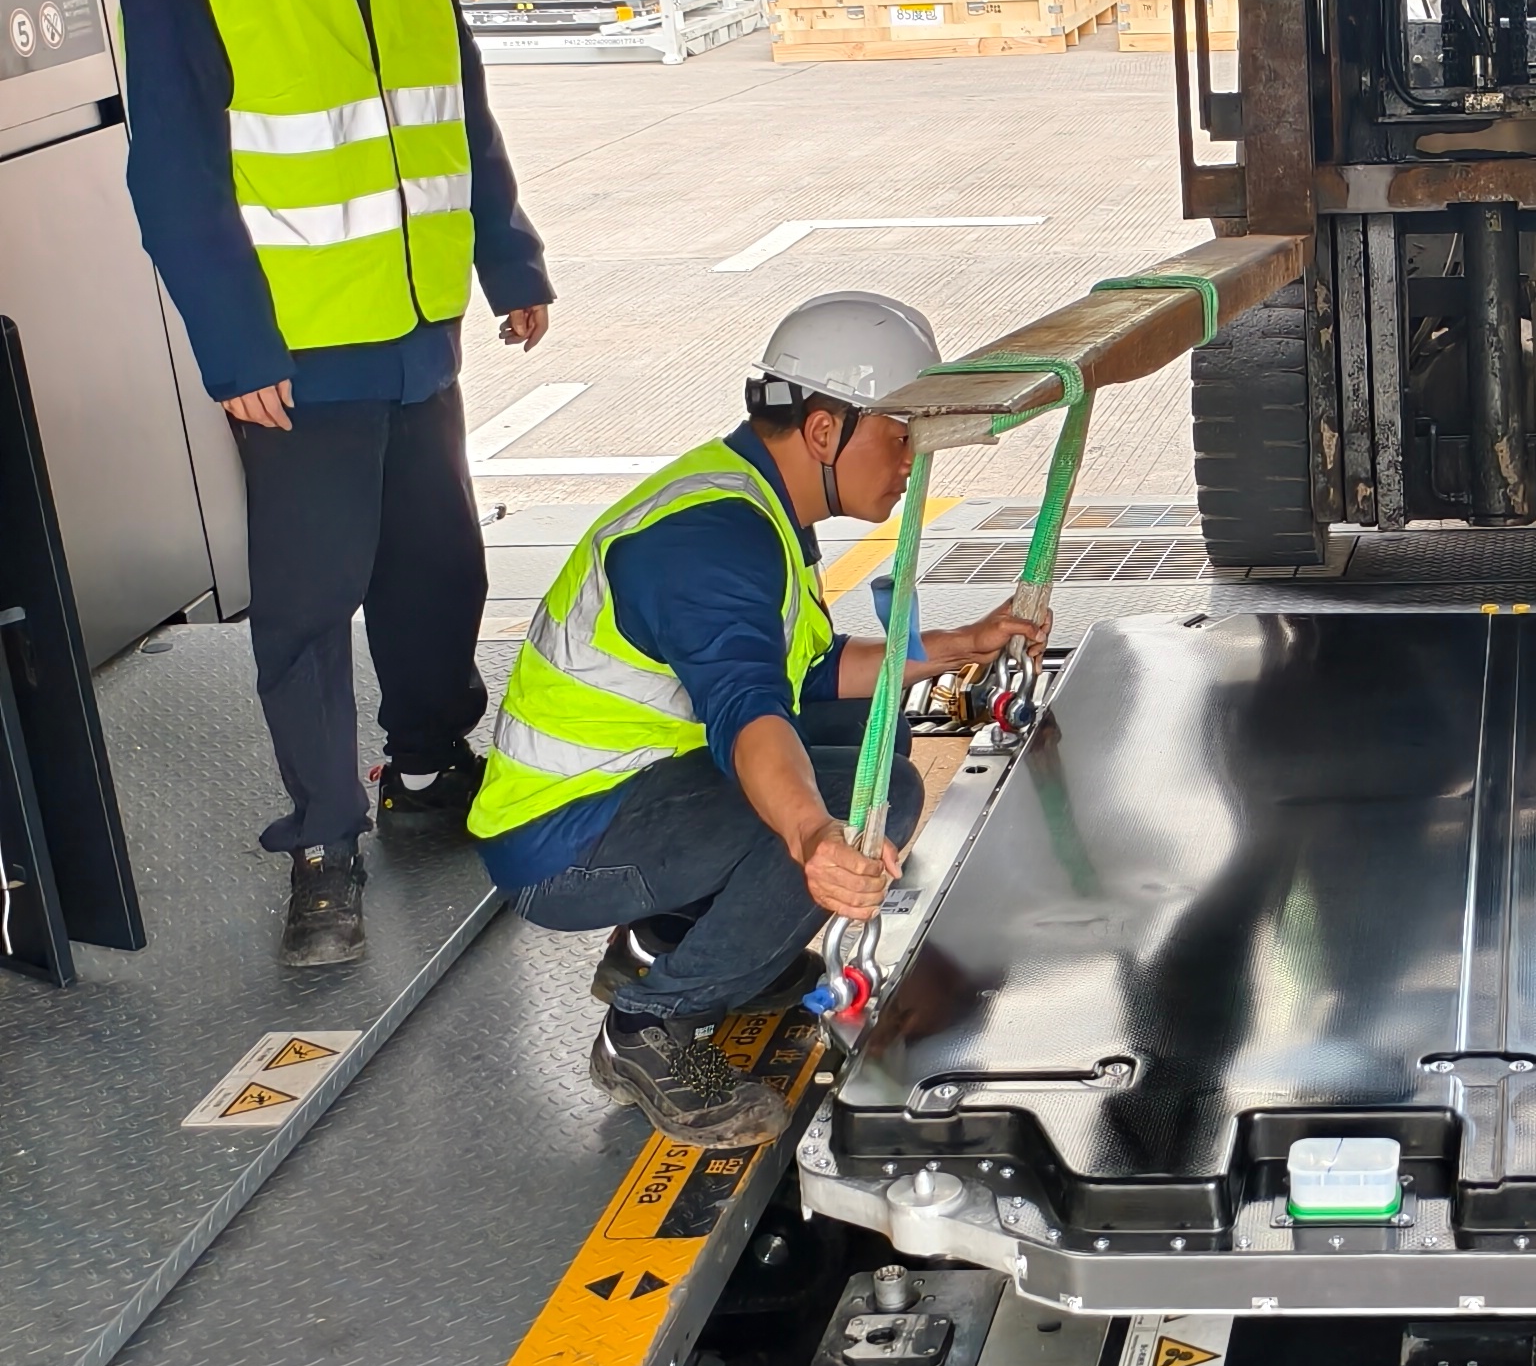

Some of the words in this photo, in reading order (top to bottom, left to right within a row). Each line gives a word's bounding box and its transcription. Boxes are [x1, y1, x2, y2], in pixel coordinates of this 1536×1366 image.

[896, 8, 938, 21] 85度包
[17, 20, 30, 48] 5
[730, 1013, 777, 1045] eep
[637, 1162, 686, 1204] Area
